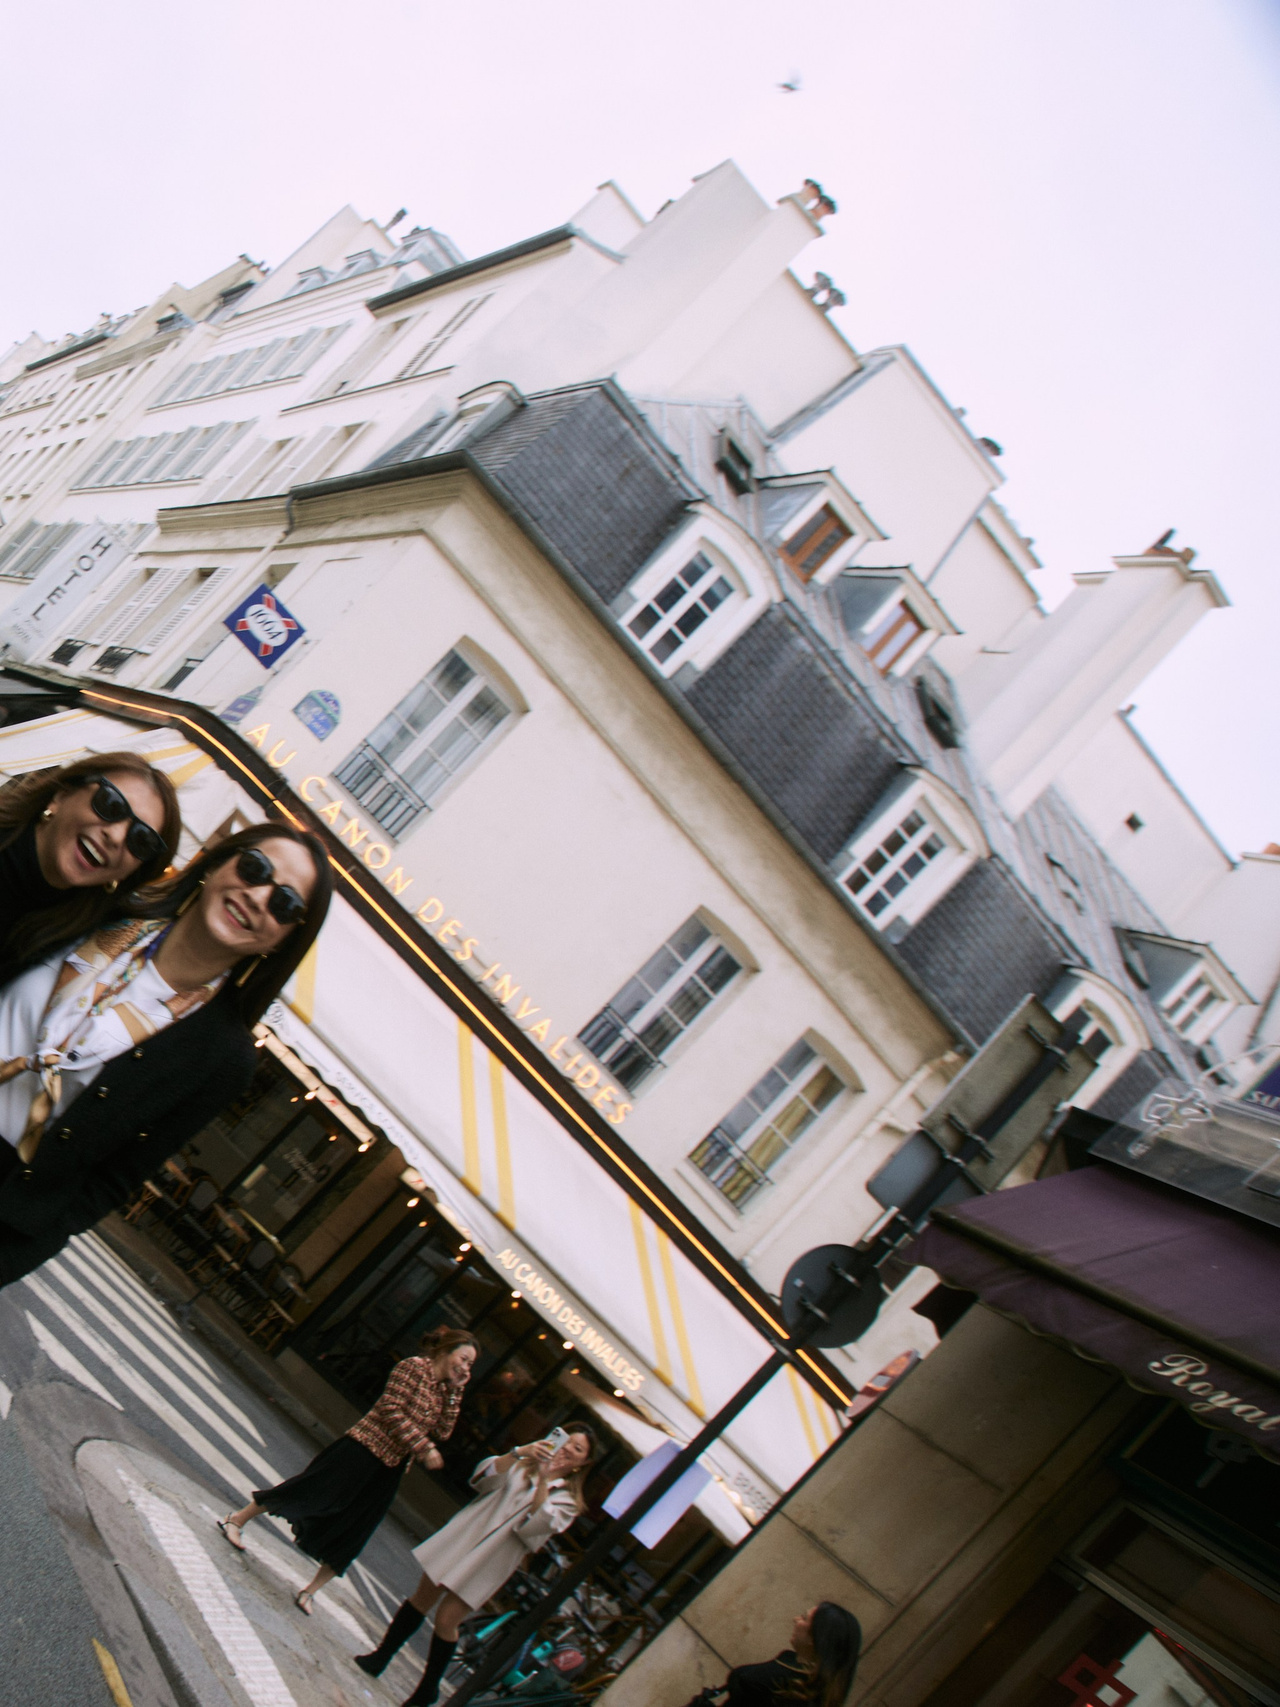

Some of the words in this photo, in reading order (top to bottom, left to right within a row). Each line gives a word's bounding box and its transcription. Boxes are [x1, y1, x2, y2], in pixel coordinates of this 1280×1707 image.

[33, 536, 112, 621] HOTEL
[248, 608, 284, 641] 1664
[245, 722, 297, 769] AU
[299, 775, 414, 896] CANON
[415, 897, 480, 961] DES
[482, 962, 633, 1125] INVALIDES
[496, 1248, 520, 1270] AU
[513, 1263, 565, 1314] CANON
[556, 1306, 586, 1335] DES
[579, 1327, 645, 1391] INVALIDES
